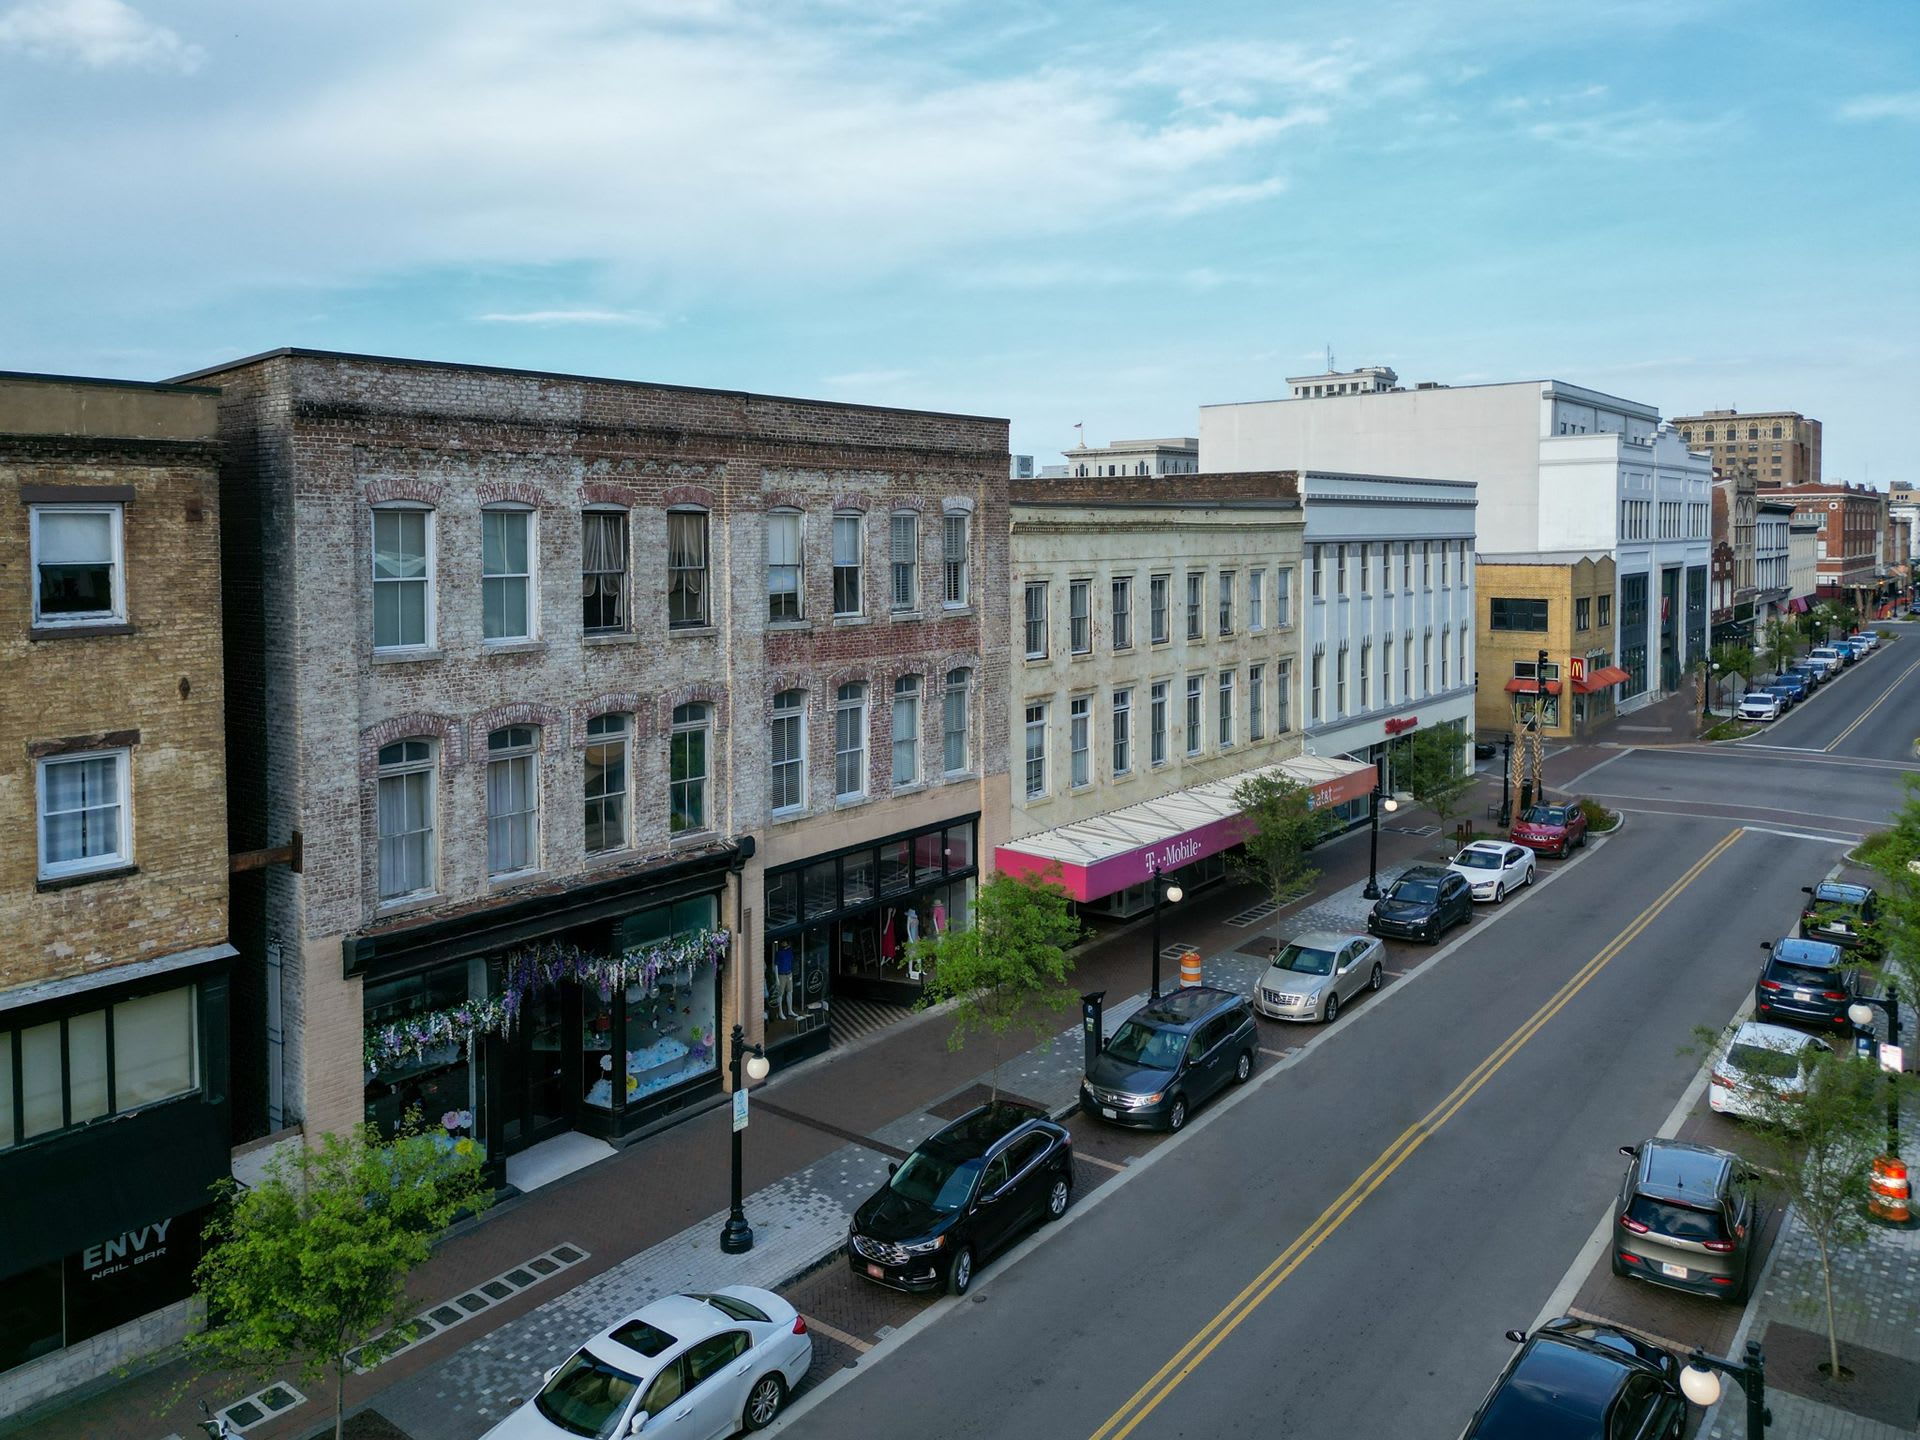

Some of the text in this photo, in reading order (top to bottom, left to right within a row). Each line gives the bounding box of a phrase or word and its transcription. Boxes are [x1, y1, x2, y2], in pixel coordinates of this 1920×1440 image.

[1859, 1038, 1867, 1048] P
[83, 1217, 172, 1271] ENVY
[91, 1247, 167, 1281] NAIL BAR
